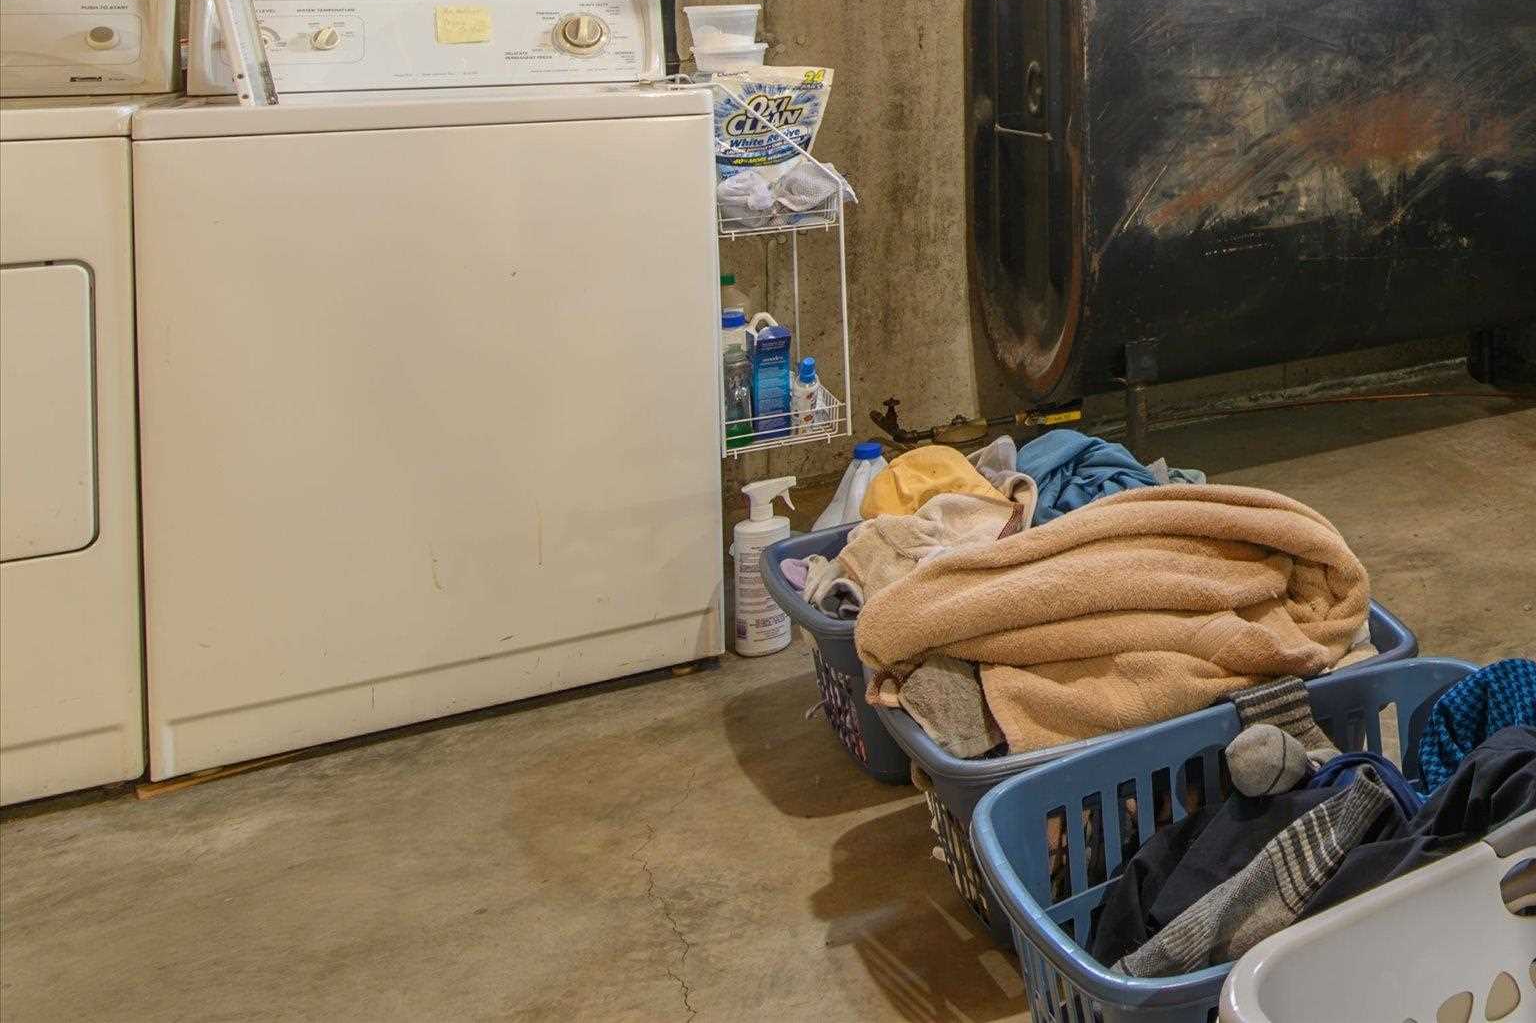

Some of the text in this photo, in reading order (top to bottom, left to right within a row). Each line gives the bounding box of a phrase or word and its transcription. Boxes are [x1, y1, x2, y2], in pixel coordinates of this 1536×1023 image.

[746, 94, 792, 118] OXI
[726, 109, 803, 137] CLEAN
[730, 138, 765, 148] White
